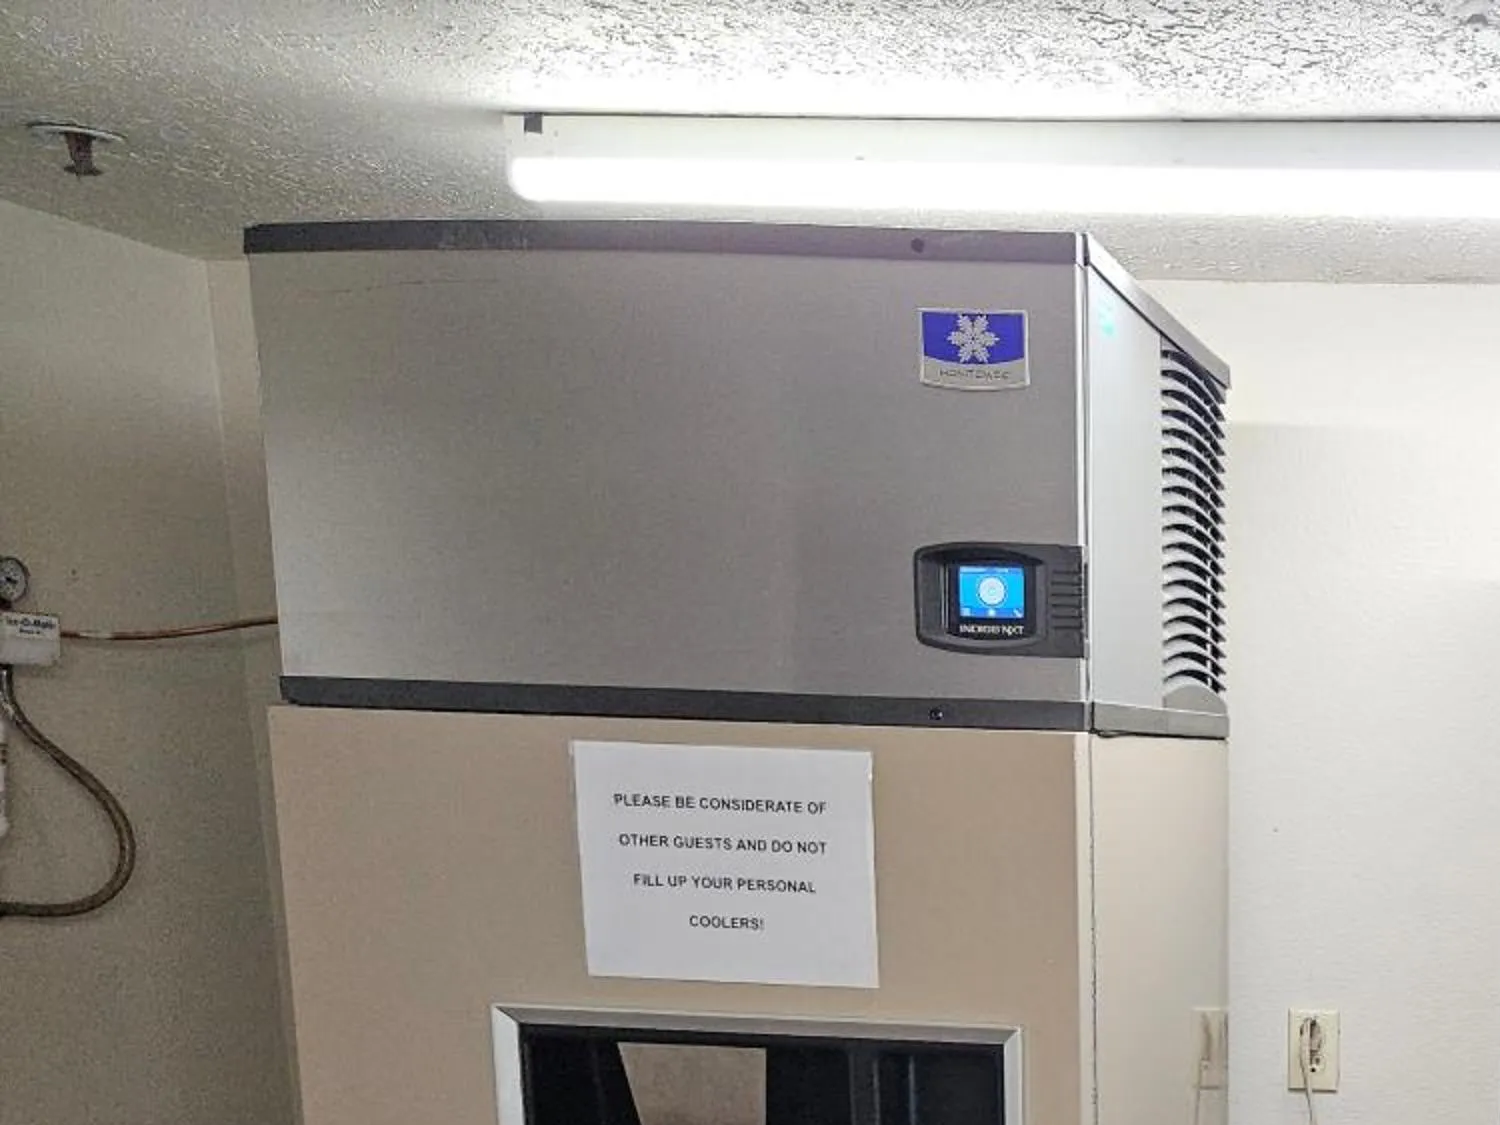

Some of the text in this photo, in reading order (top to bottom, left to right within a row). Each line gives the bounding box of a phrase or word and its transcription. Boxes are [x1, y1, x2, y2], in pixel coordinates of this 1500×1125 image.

[613, 793, 827, 815] PLEASE BE CONSIDERATE OF
[618, 833, 827, 854] OTHER GUESTS AND DO NOT
[633, 873, 816, 894] FILL UP YOUR PERSONAL
[688, 915, 765, 931] COOLERS!
